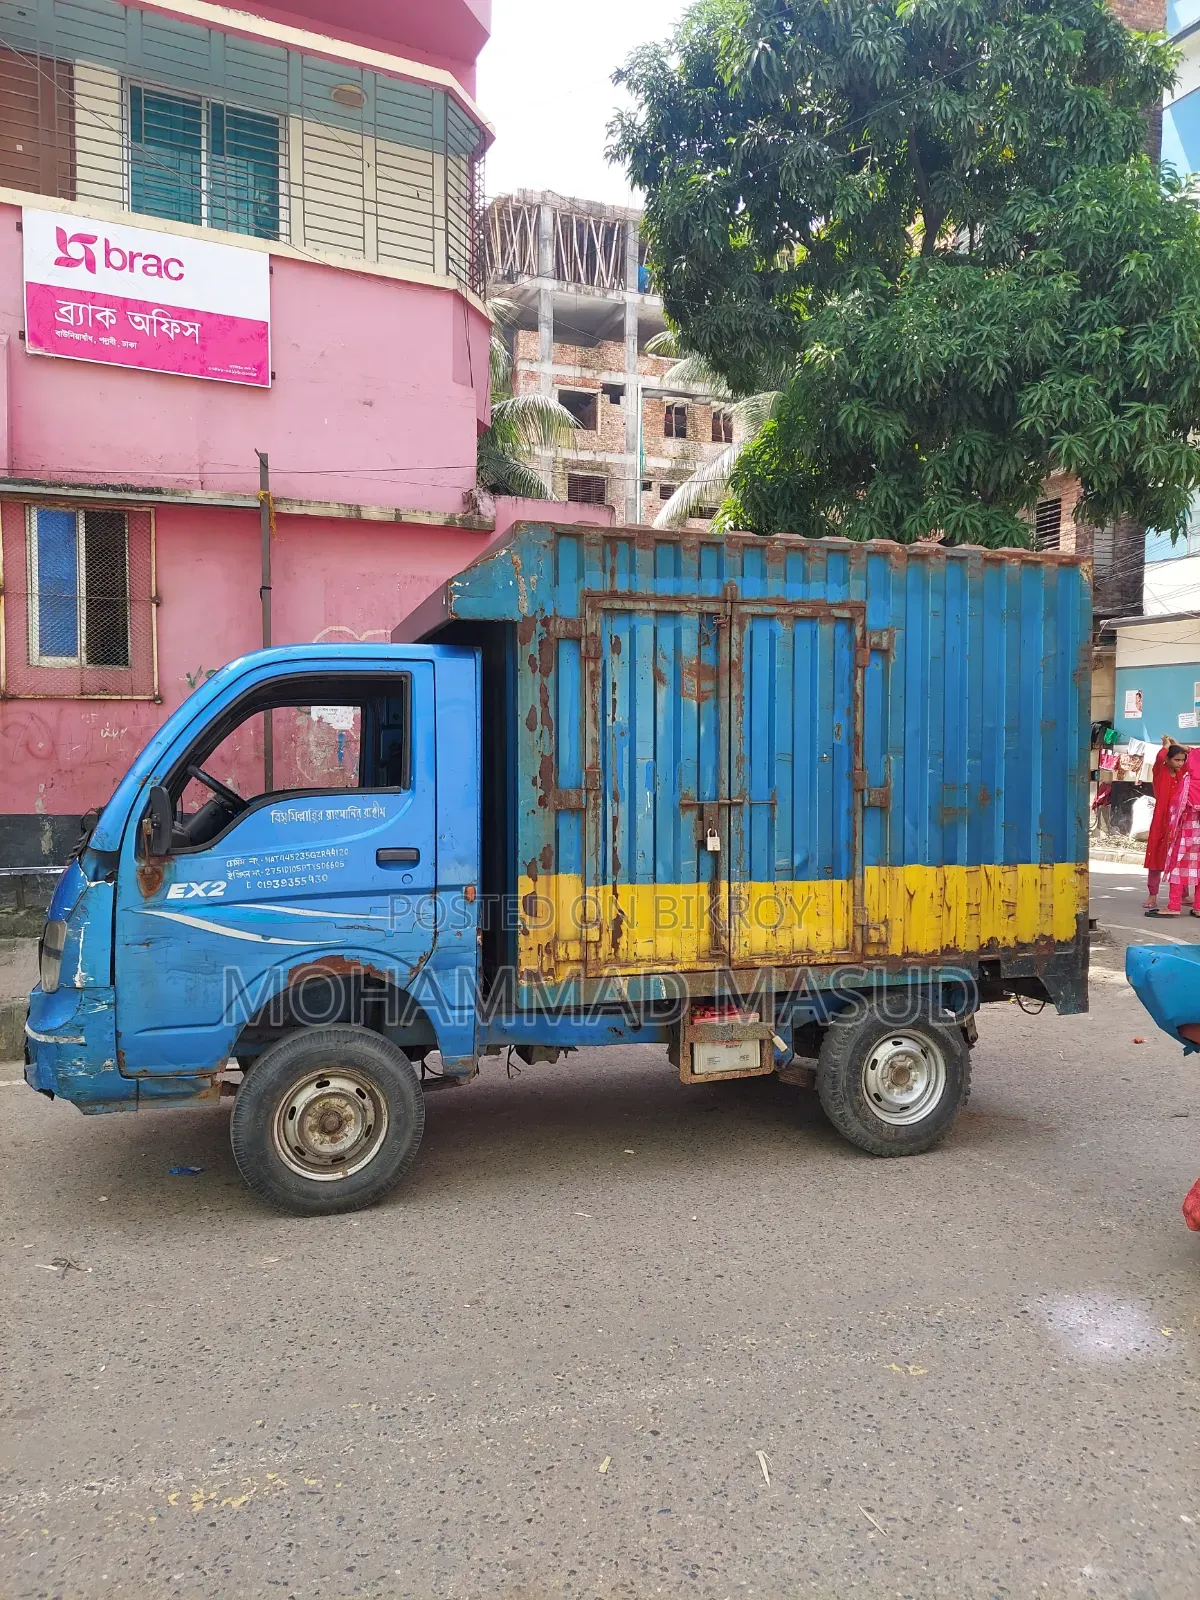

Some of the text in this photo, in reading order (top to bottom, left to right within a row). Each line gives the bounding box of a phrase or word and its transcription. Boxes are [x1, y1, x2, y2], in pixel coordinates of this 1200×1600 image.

[104, 238, 185, 281] brac
[54, 299, 202, 344] ব্র্যাক অফিস
[166, 880, 227, 900] EX2
